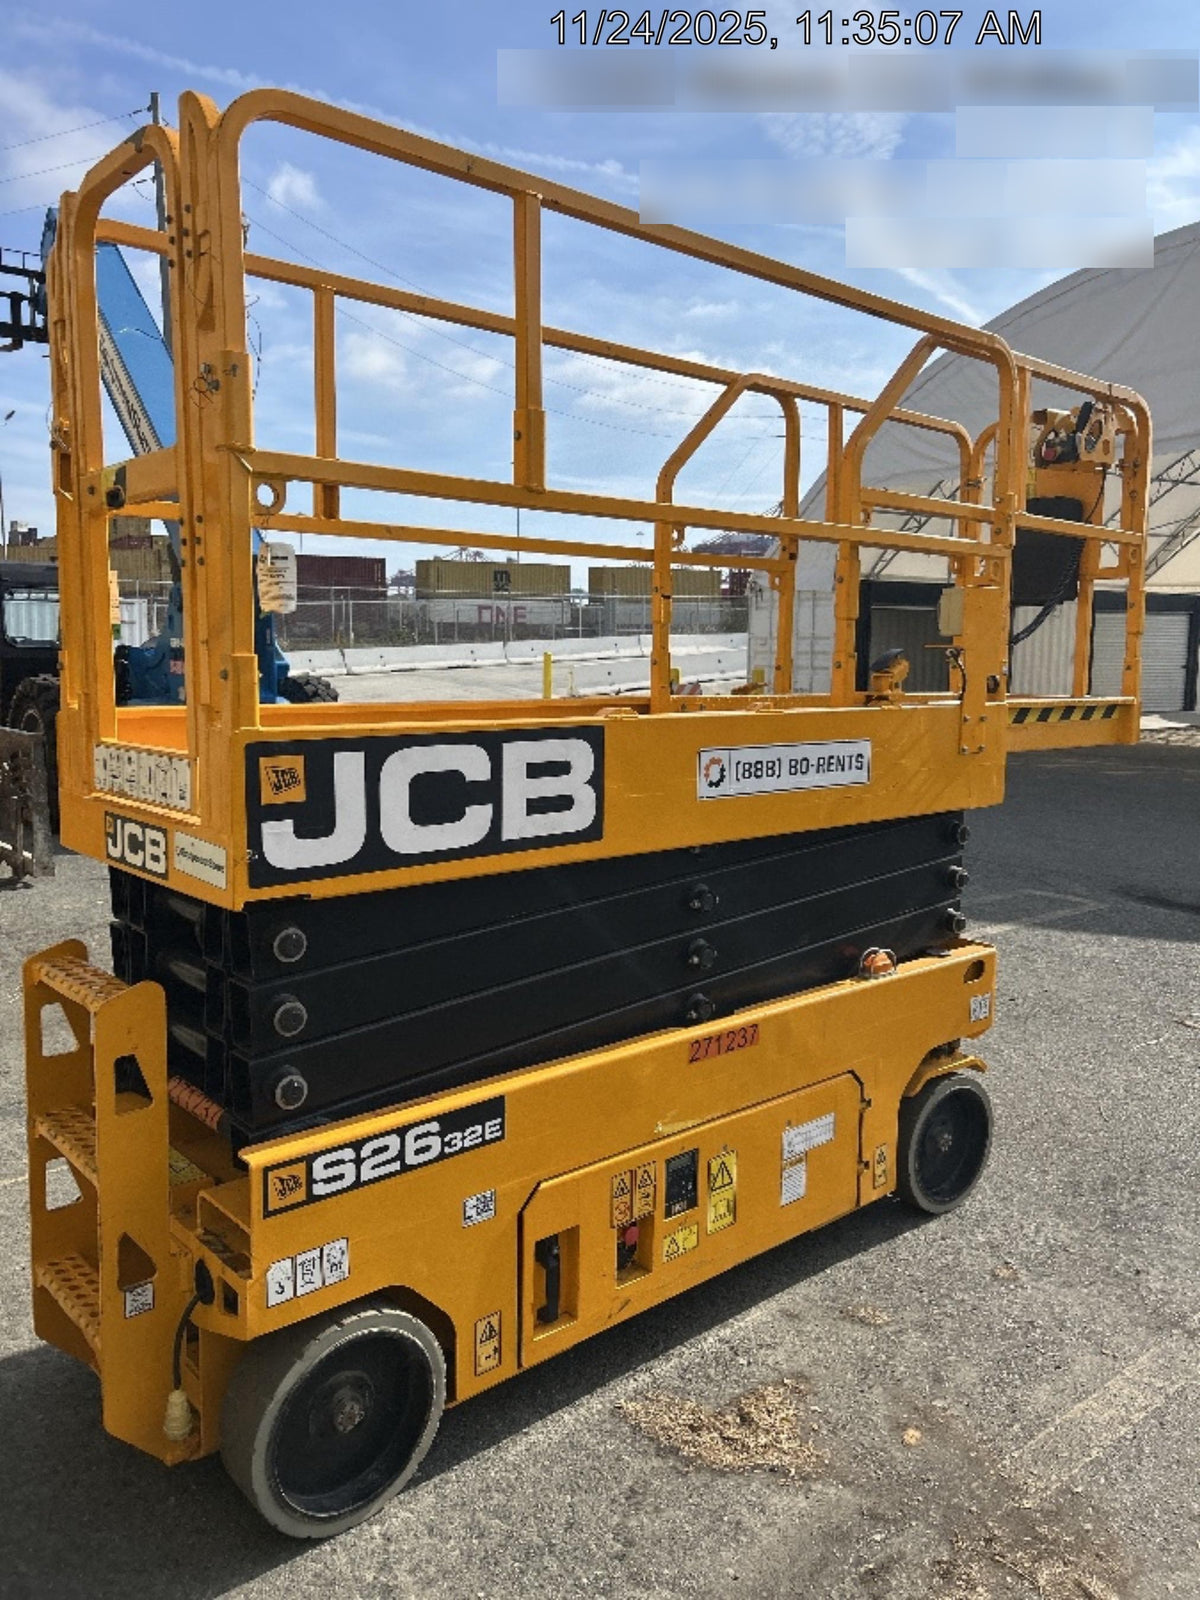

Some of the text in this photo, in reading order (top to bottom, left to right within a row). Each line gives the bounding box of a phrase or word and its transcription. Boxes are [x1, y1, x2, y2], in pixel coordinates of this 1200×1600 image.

[260, 738, 597, 870] JCB
[107, 818, 167, 874] JCB
[688, 1023, 759, 1064] 271237
